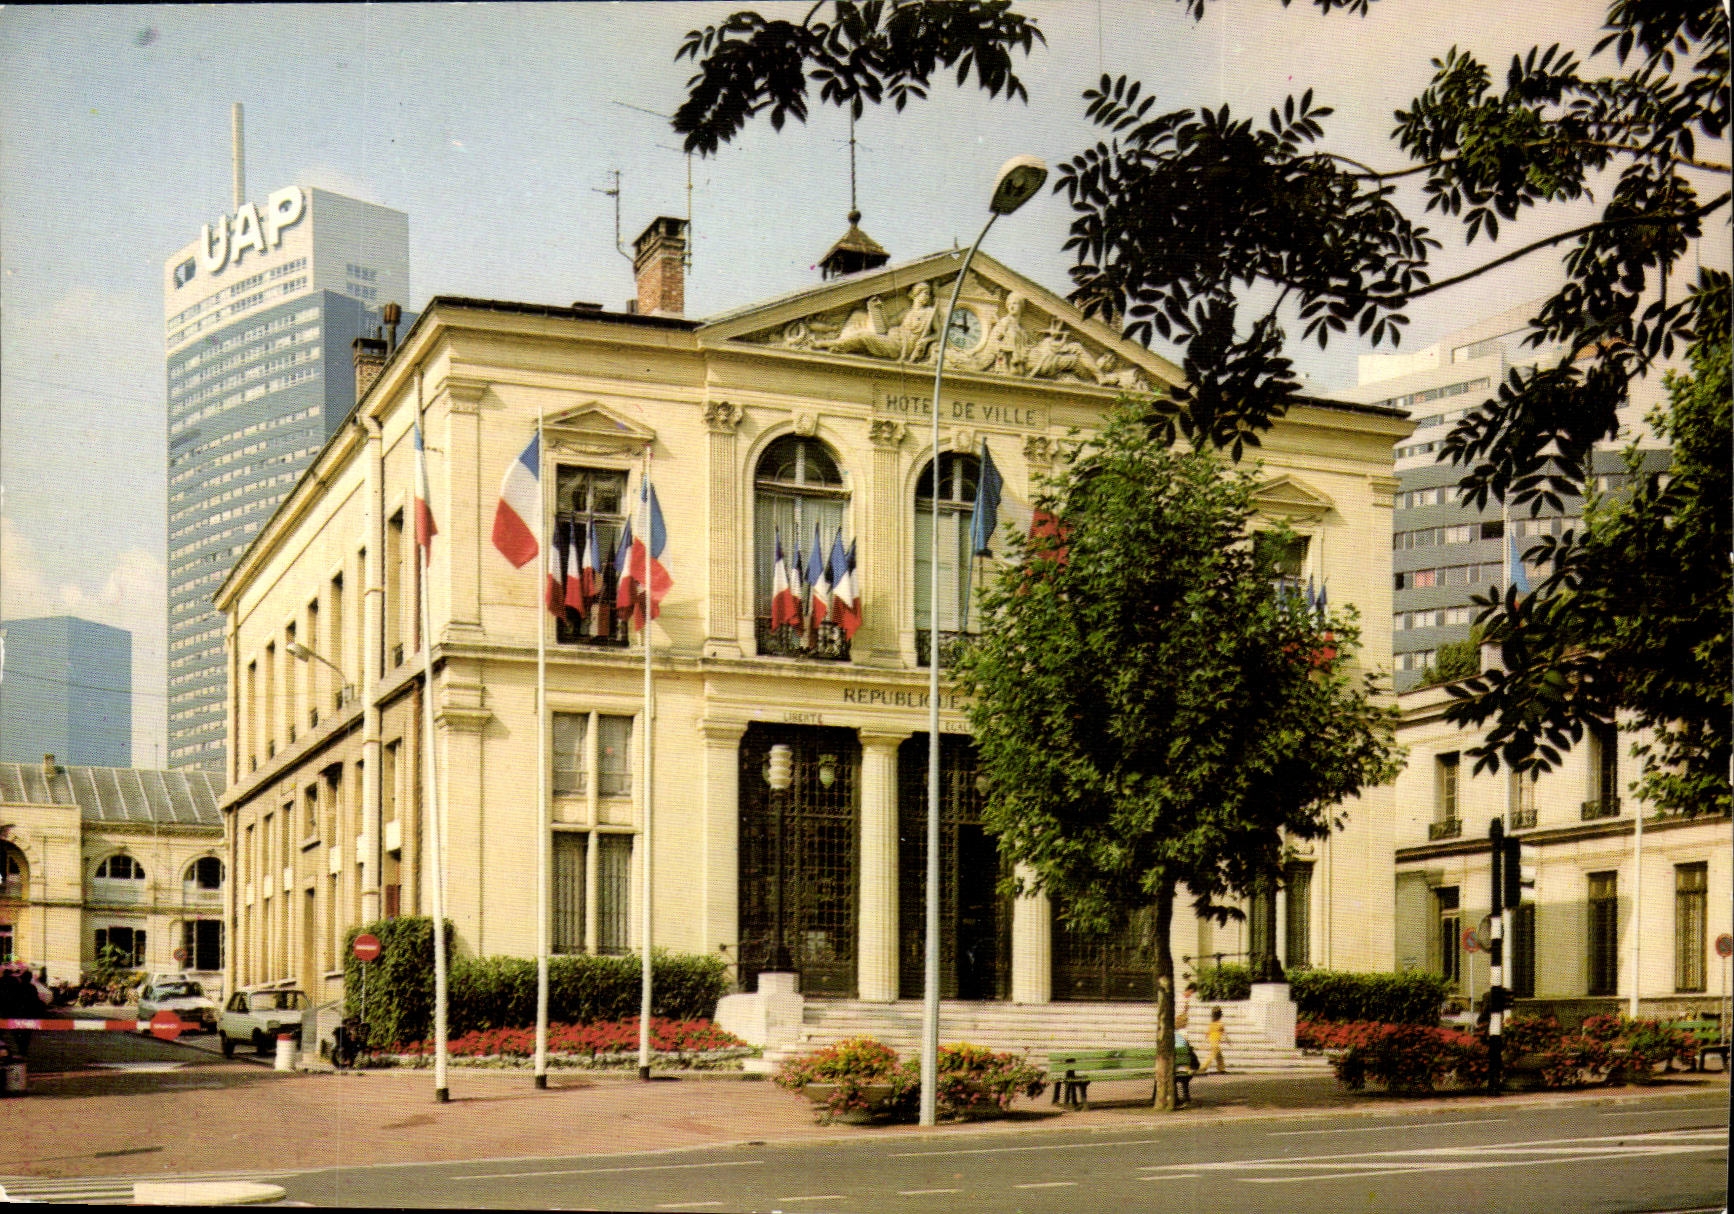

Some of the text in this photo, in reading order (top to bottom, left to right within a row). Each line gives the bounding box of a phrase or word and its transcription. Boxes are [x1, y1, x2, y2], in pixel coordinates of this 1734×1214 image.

[201, 185, 306, 276] UAP
[952, 401, 976, 420] DE
[982, 405, 1037, 427] VILLE
